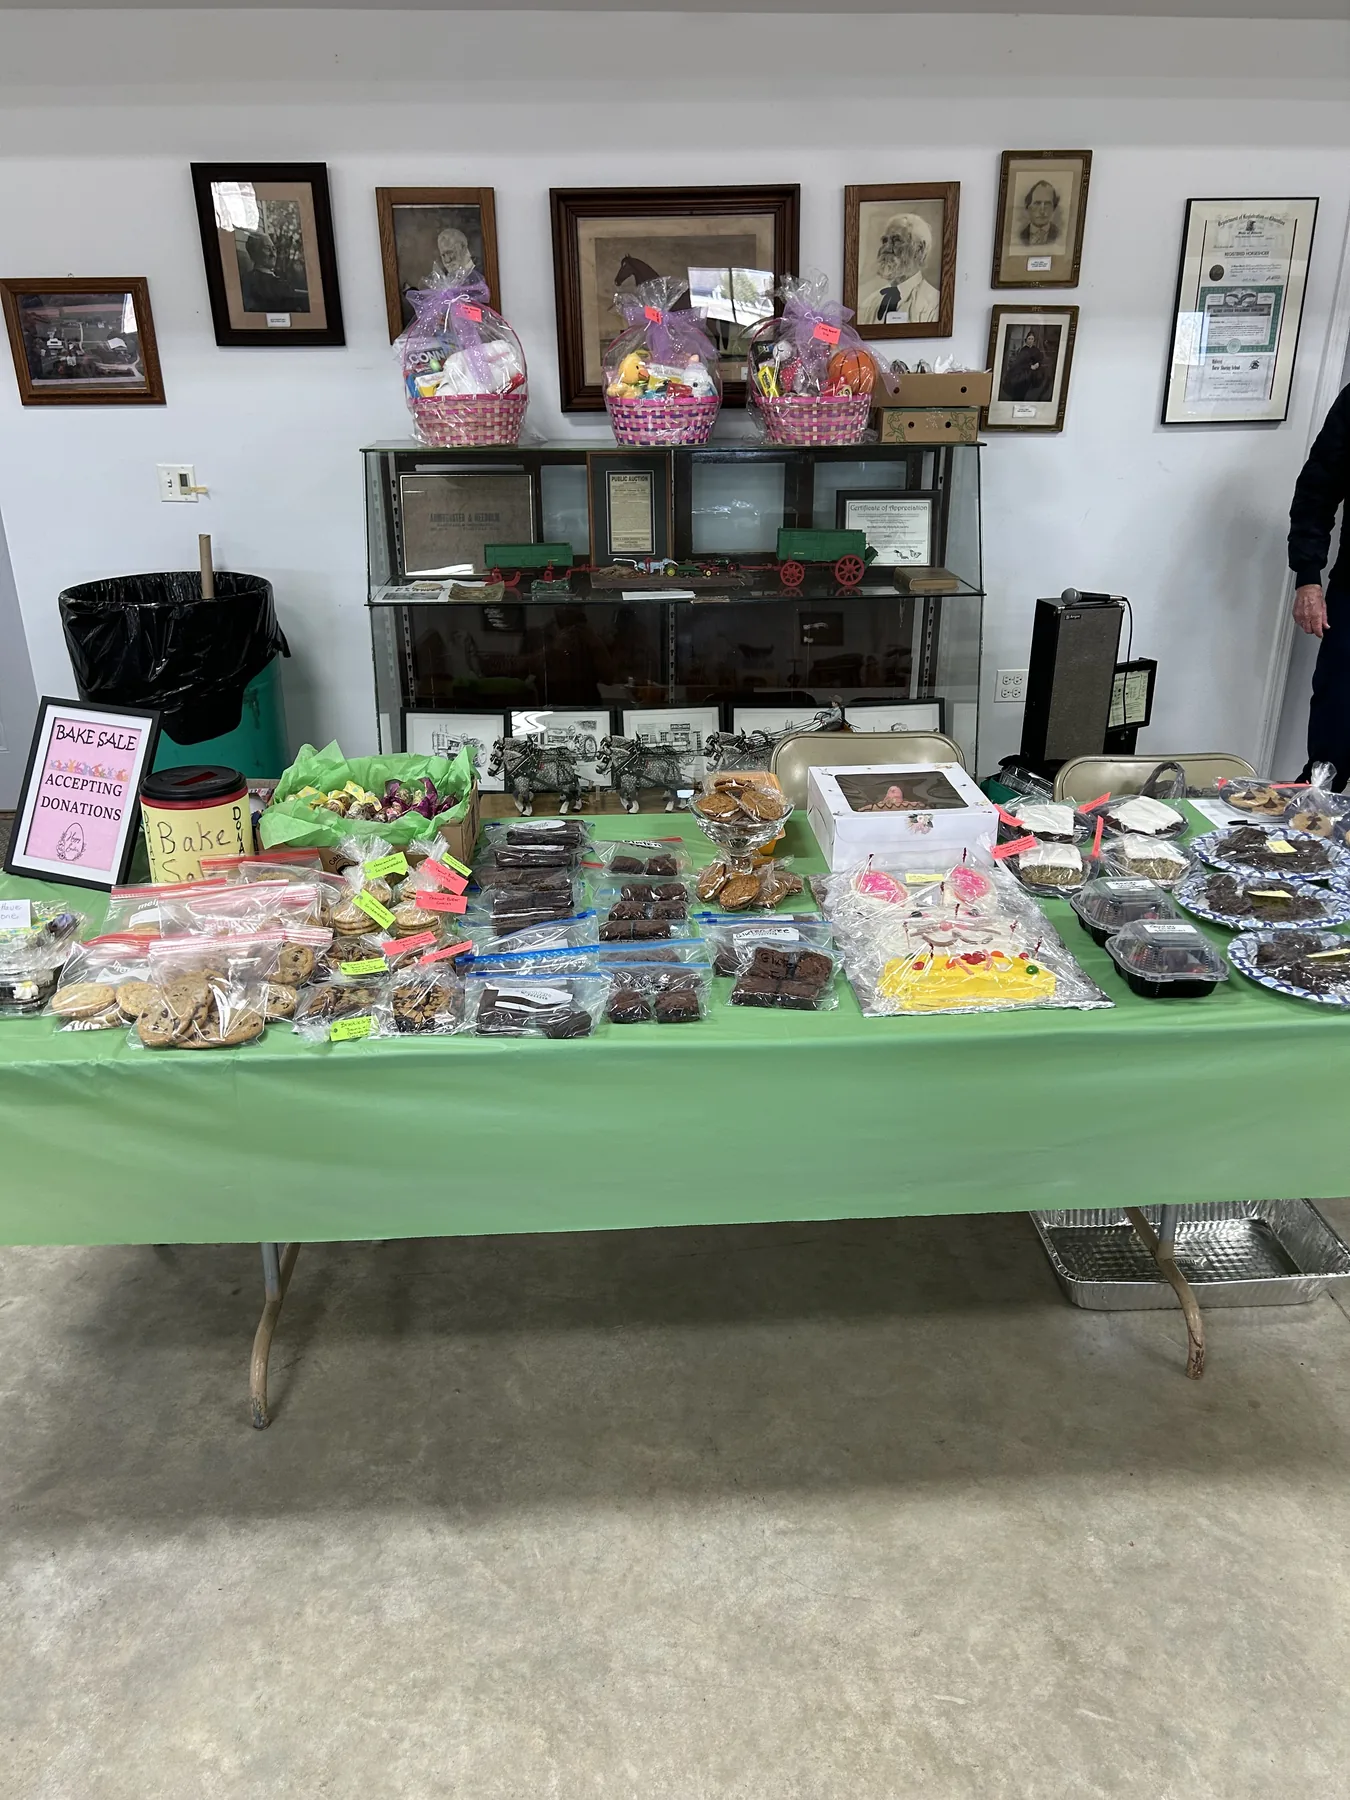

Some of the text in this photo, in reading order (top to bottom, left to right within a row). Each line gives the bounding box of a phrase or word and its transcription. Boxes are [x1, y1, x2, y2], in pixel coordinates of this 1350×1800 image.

[409, 350, 446, 363] CONN
[850, 504, 928, 512] Certificate of Appreciation
[56, 724, 137, 751] BAKE SALE
[44, 773, 123, 797] ACCEPTING
[40, 796, 122, 821] DONATIONS
[157, 821, 231, 855] Bake
[232, 806, 245, 856] DONA
[162, 858, 205, 883] Sal
[138, 899, 159, 910] meij
